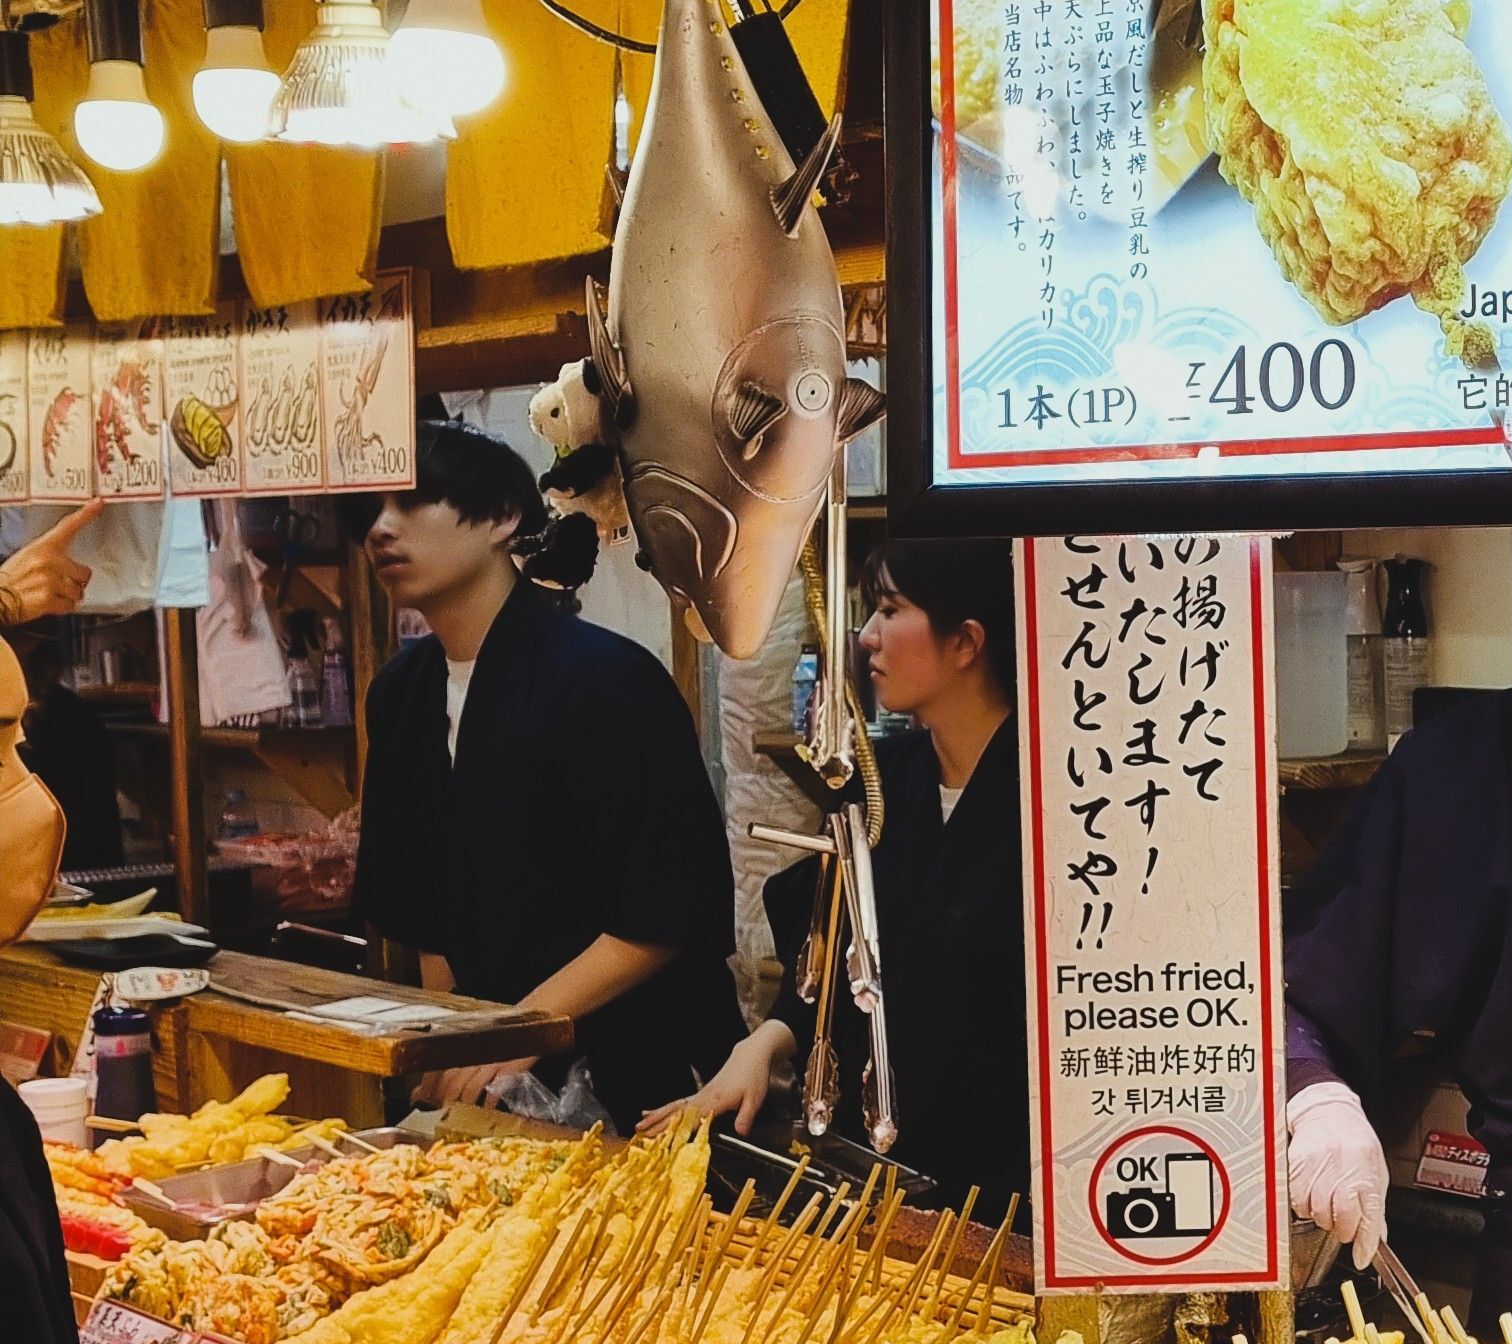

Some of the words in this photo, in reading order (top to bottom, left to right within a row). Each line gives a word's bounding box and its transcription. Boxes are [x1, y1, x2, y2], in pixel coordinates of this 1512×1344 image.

[995, 383, 1138, 433] 1本(1P)
[1056, 964, 1155, 998] Fresh
[1160, 960, 1256, 997] fried,
[1064, 998, 1180, 1040] please
[1186, 997, 1249, 1030] OK.
[1059, 1044, 1256, 1078] 新鲜油炸好的
[1091, 1088, 1118, 1116] 갓
[1123, 1086, 1227, 1116] 튀겨서콜
[1116, 1156, 1159, 1182] OK
